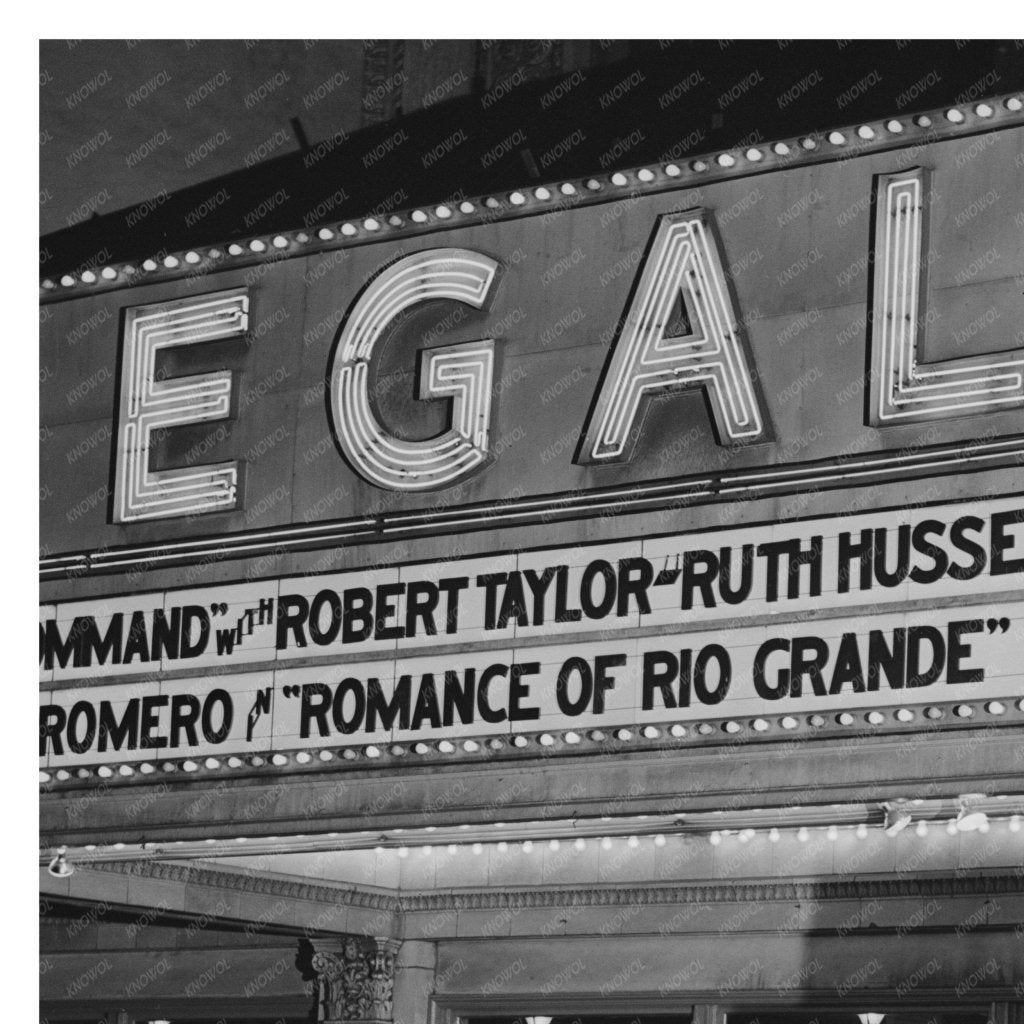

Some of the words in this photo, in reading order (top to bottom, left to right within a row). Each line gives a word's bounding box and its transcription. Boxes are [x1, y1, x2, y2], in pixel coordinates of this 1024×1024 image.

[276, 577, 469, 650] ROBERT
[39, 688, 233, 757] ROMERO
[556, 653, 627, 716] OF
[642, 643, 732, 711] RIO
